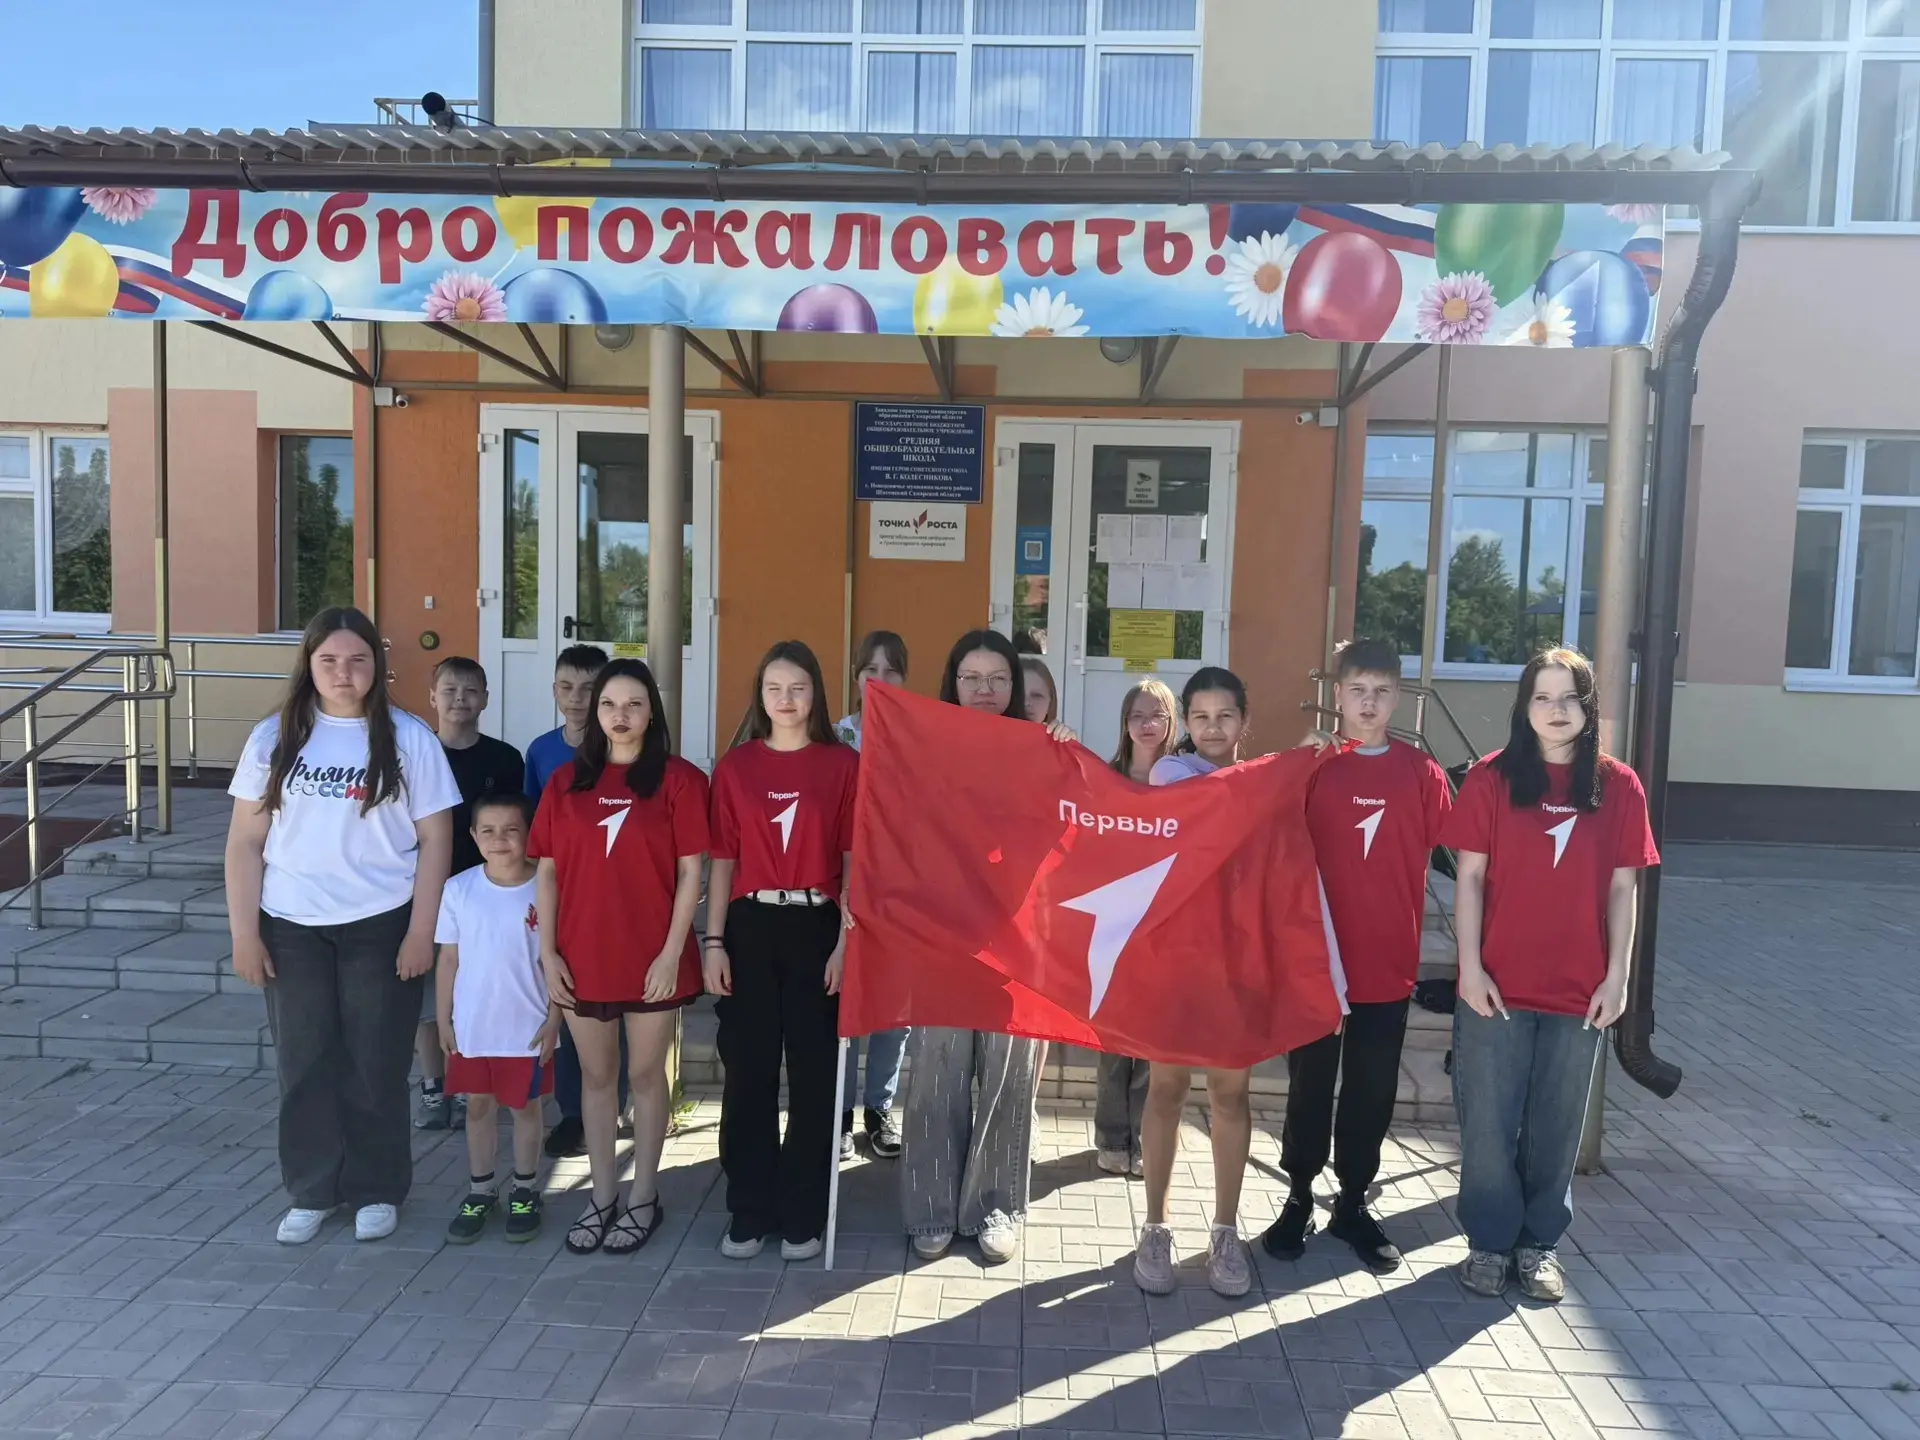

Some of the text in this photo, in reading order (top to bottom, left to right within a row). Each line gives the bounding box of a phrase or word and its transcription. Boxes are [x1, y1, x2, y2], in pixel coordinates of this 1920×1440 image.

[172, 189, 1231, 284] Добро пожаловать!
[899, 437, 940, 445] СРЕДНЯЯ
[864, 445, 975, 455] ОБЩЕОБРАЗОВАТЕЛЬНАЯ
[878, 519, 958, 529] ТОЧКА РОСТА
[289, 781, 368, 801] РОССИ
[768, 791, 800, 801] Первые
[598, 797, 633, 806] Первые
[1352, 796, 1386, 807] Первые
[1059, 799, 1179, 838] Первые
